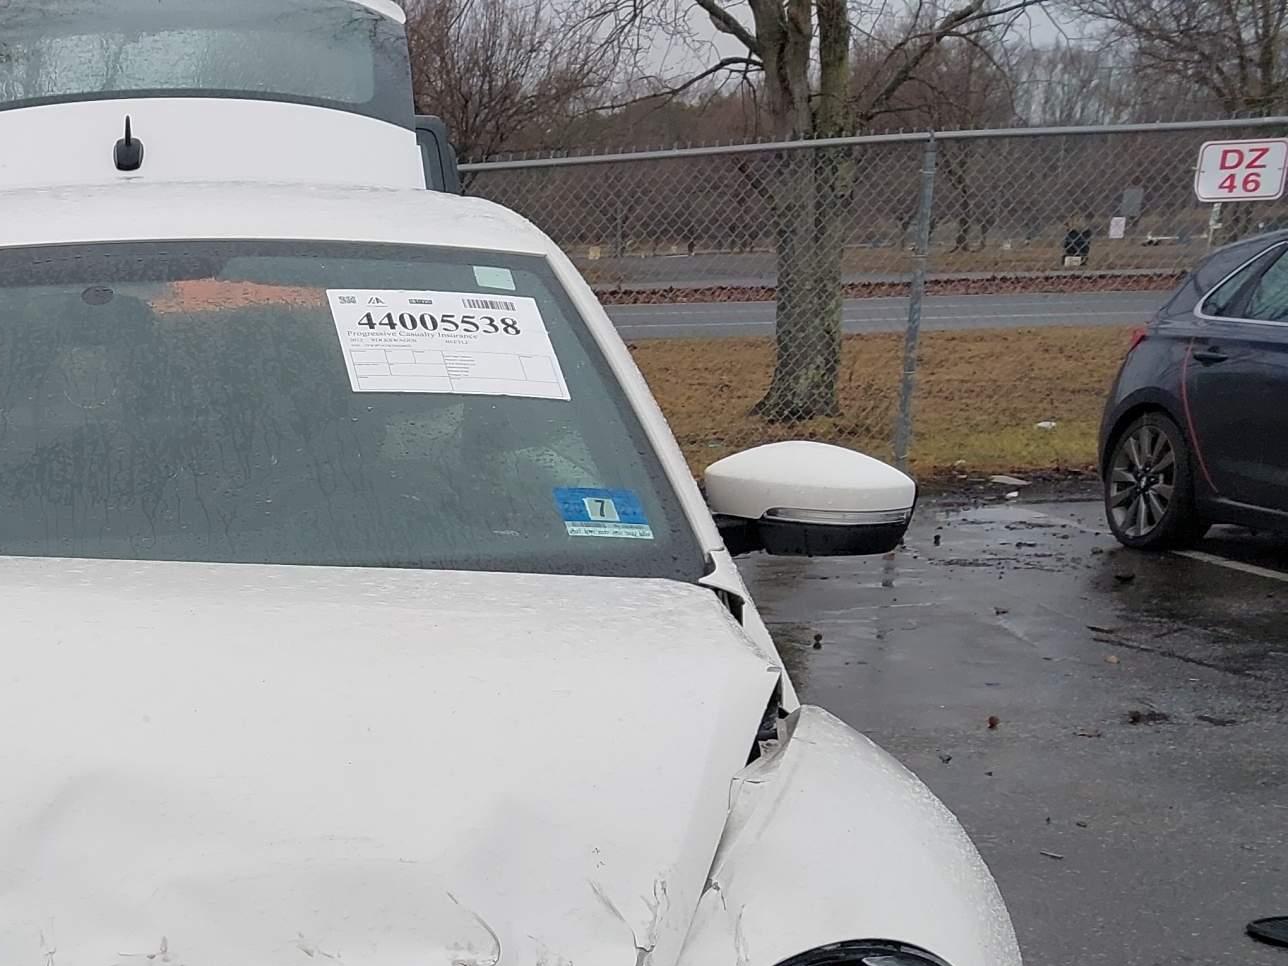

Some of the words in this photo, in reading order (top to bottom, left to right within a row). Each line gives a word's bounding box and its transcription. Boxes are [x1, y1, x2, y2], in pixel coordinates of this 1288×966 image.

[1219, 147, 1270, 170] DZ
[1218, 172, 1261, 193] 46
[347, 330, 397, 338] Progressive
[357, 311, 521, 336] 44005538
[594, 499, 606, 518] 7
